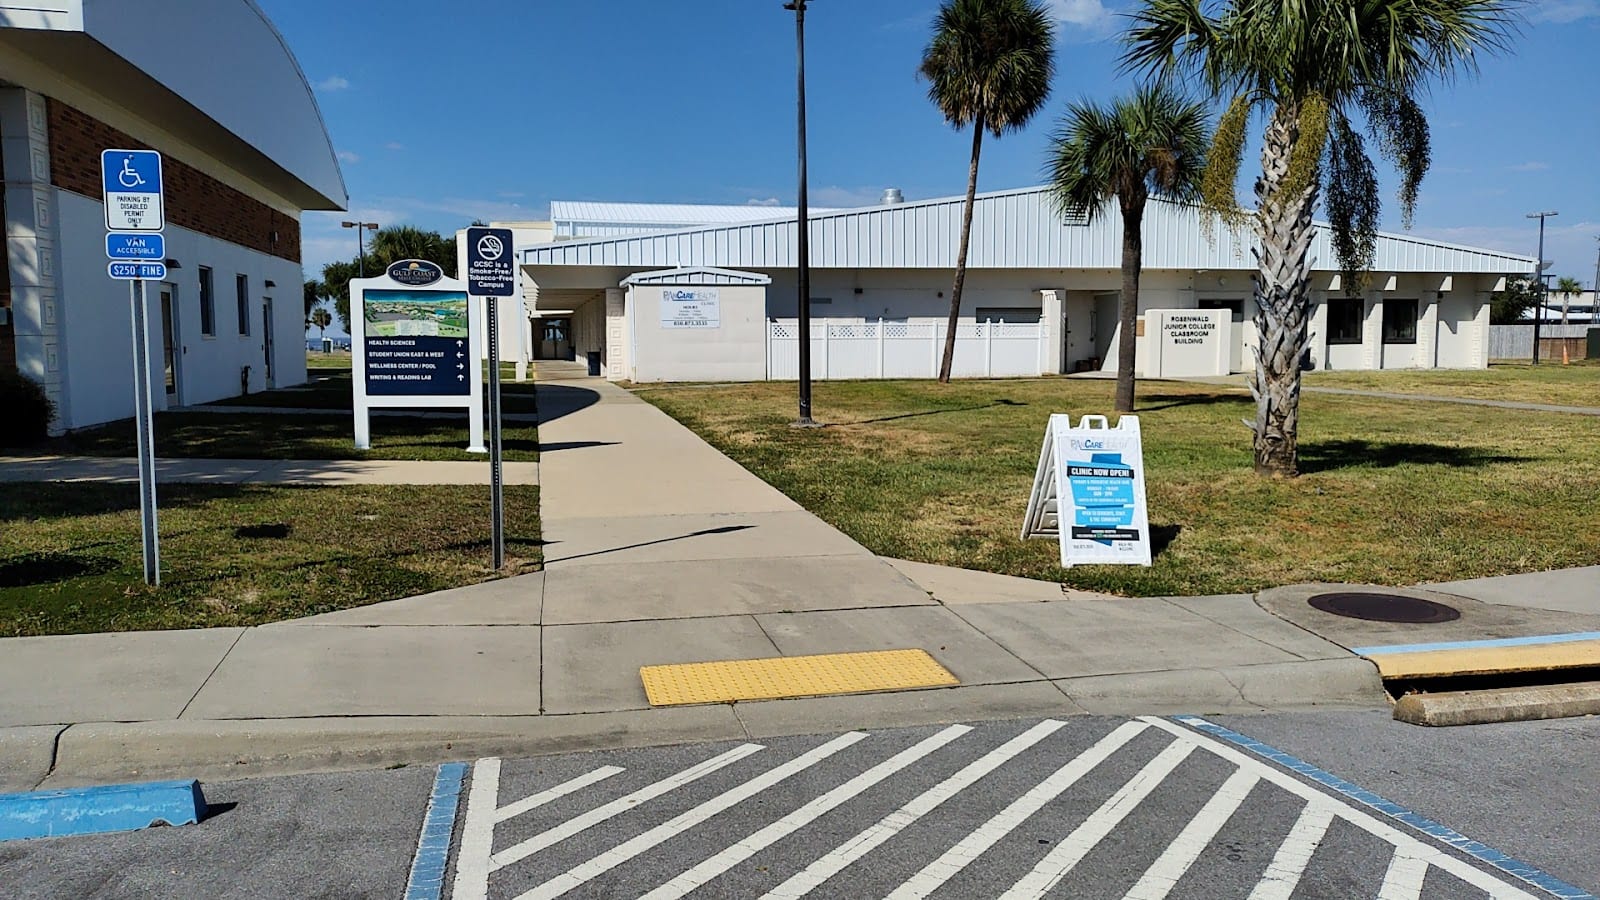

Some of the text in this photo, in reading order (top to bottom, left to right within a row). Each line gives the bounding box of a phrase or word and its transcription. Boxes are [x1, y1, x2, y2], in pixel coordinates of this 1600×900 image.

[126, 238, 146, 247] VAN
[113, 264, 162, 276] $250 FINE
[1093, 468, 1109, 476] NOW
[1110, 469, 1130, 477] OPEN!
